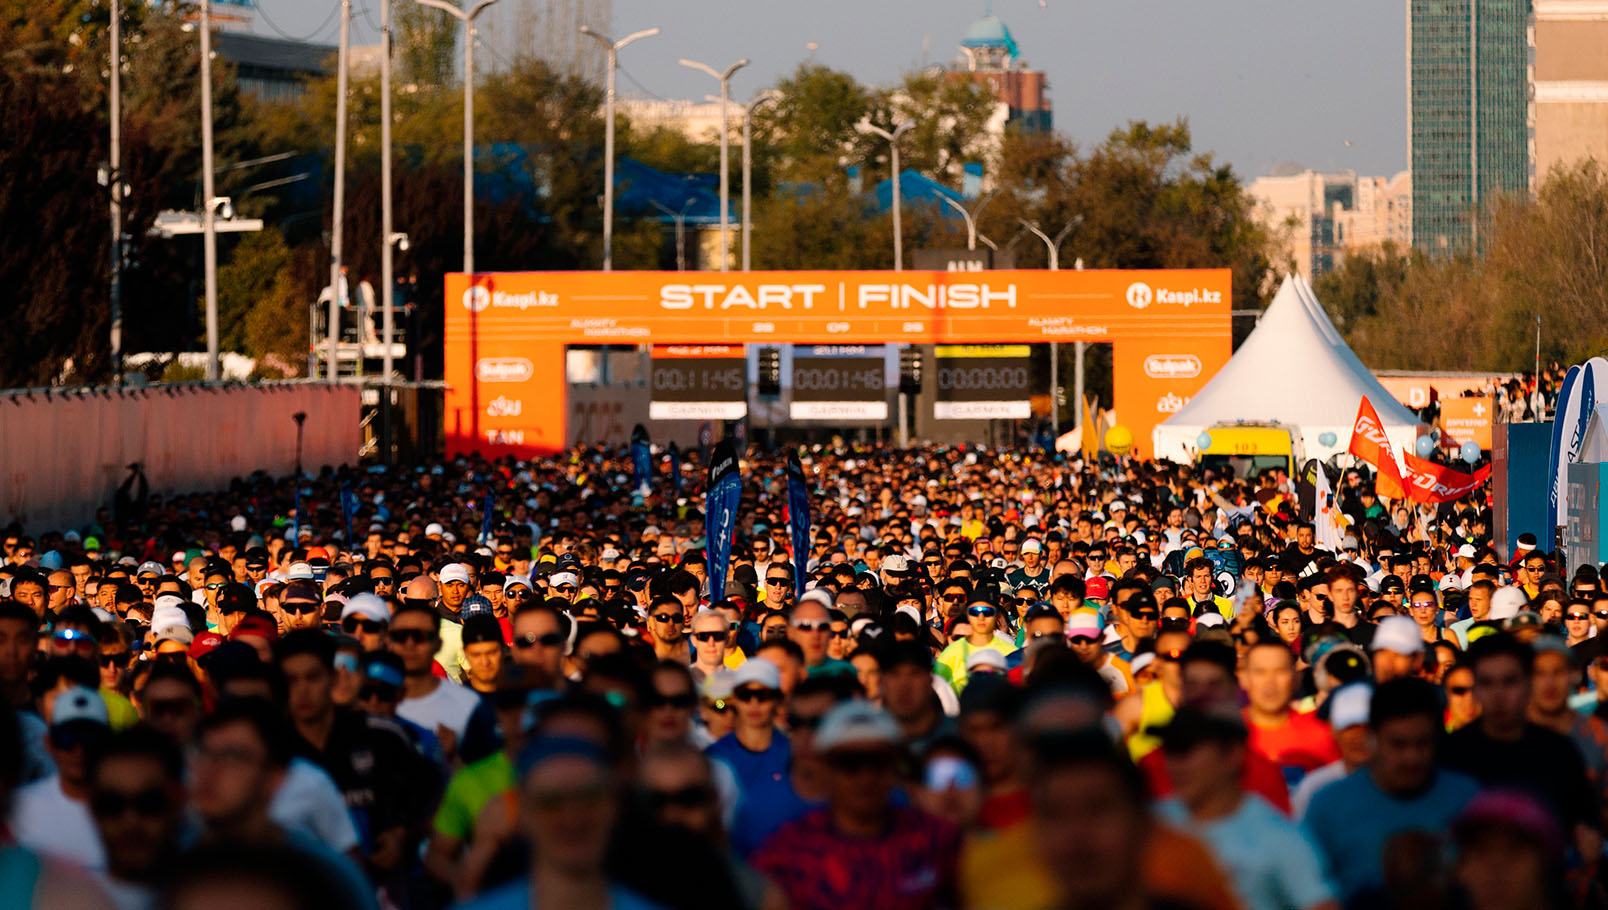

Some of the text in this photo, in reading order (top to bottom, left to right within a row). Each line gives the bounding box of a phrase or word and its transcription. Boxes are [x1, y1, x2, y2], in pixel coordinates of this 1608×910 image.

[493, 291, 559, 310] Kaspi.kz
[660, 284, 1017, 309] START FINISH
[1156, 288, 1221, 307] Kaspi.kz
[1410, 388, 1425, 407] D
[485, 430, 524, 444] TAN
[1235, 443, 1258, 453] 103
